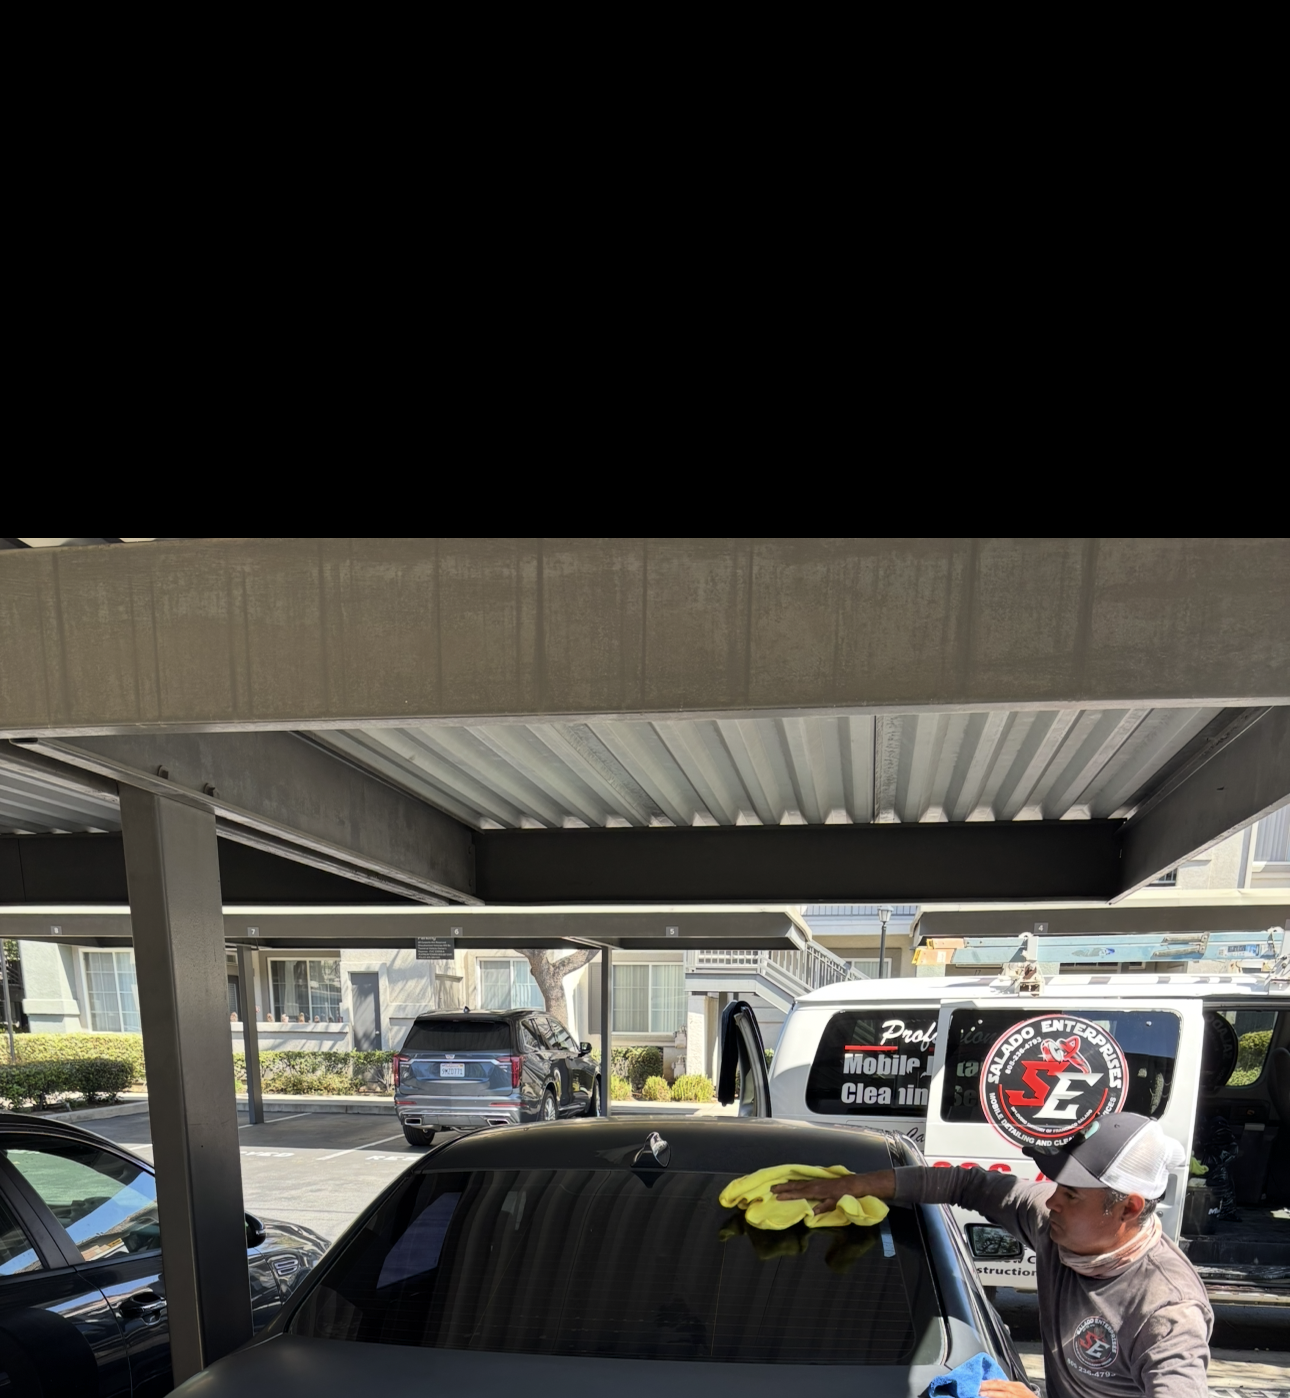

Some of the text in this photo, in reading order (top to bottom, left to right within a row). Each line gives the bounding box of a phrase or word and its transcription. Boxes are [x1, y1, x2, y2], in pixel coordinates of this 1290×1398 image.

[843, 1053, 920, 1076] Mobile
[988, 1020, 1121, 1089] SALADO ENTERPRISES
[1005, 1037, 1041, 1074] 805-236-4793
[1005, 1061, 1104, 1119] SE
[989, 1092, 1004, 1119] MOBILE
[1001, 1120, 1034, 1144] DETAILING
[1035, 1139, 1053, 1147] AND
